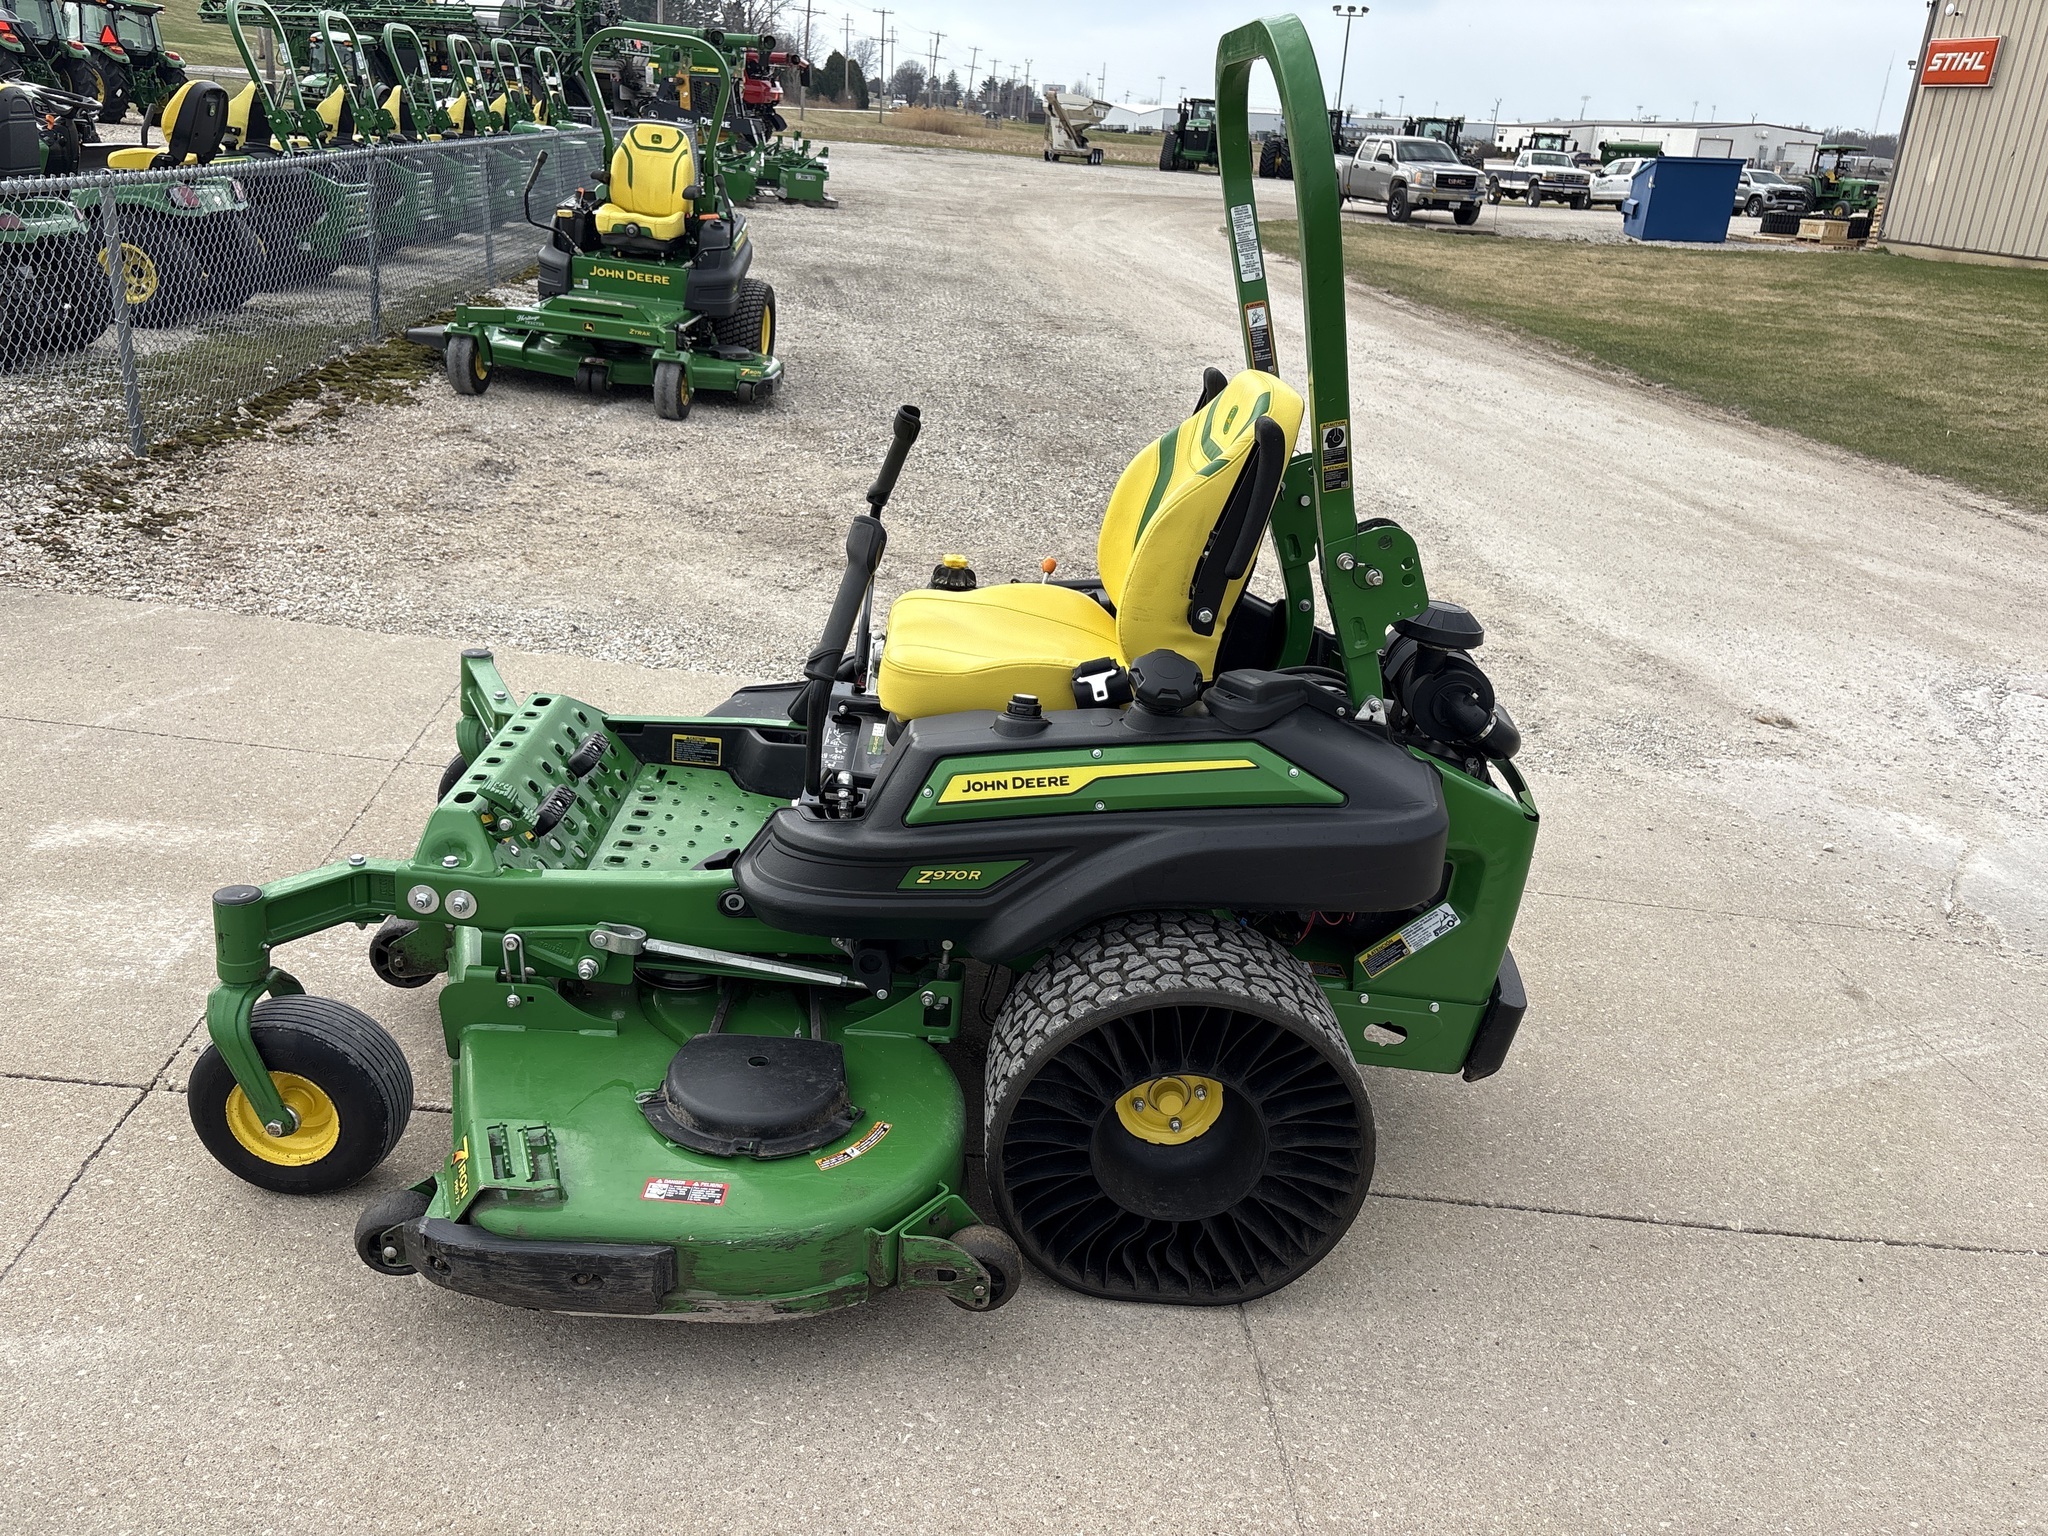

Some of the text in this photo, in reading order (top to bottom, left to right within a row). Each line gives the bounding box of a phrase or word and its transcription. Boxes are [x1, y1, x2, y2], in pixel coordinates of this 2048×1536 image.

[1927, 51, 1987, 72] STIHL
[700, 116, 731, 129] DERE
[589, 265, 670, 285] JOHN DEERE
[628, 328, 651, 337] ZTRAK
[961, 775, 1070, 793] JOHN DEERE
[915, 870, 982, 884] Z970R
